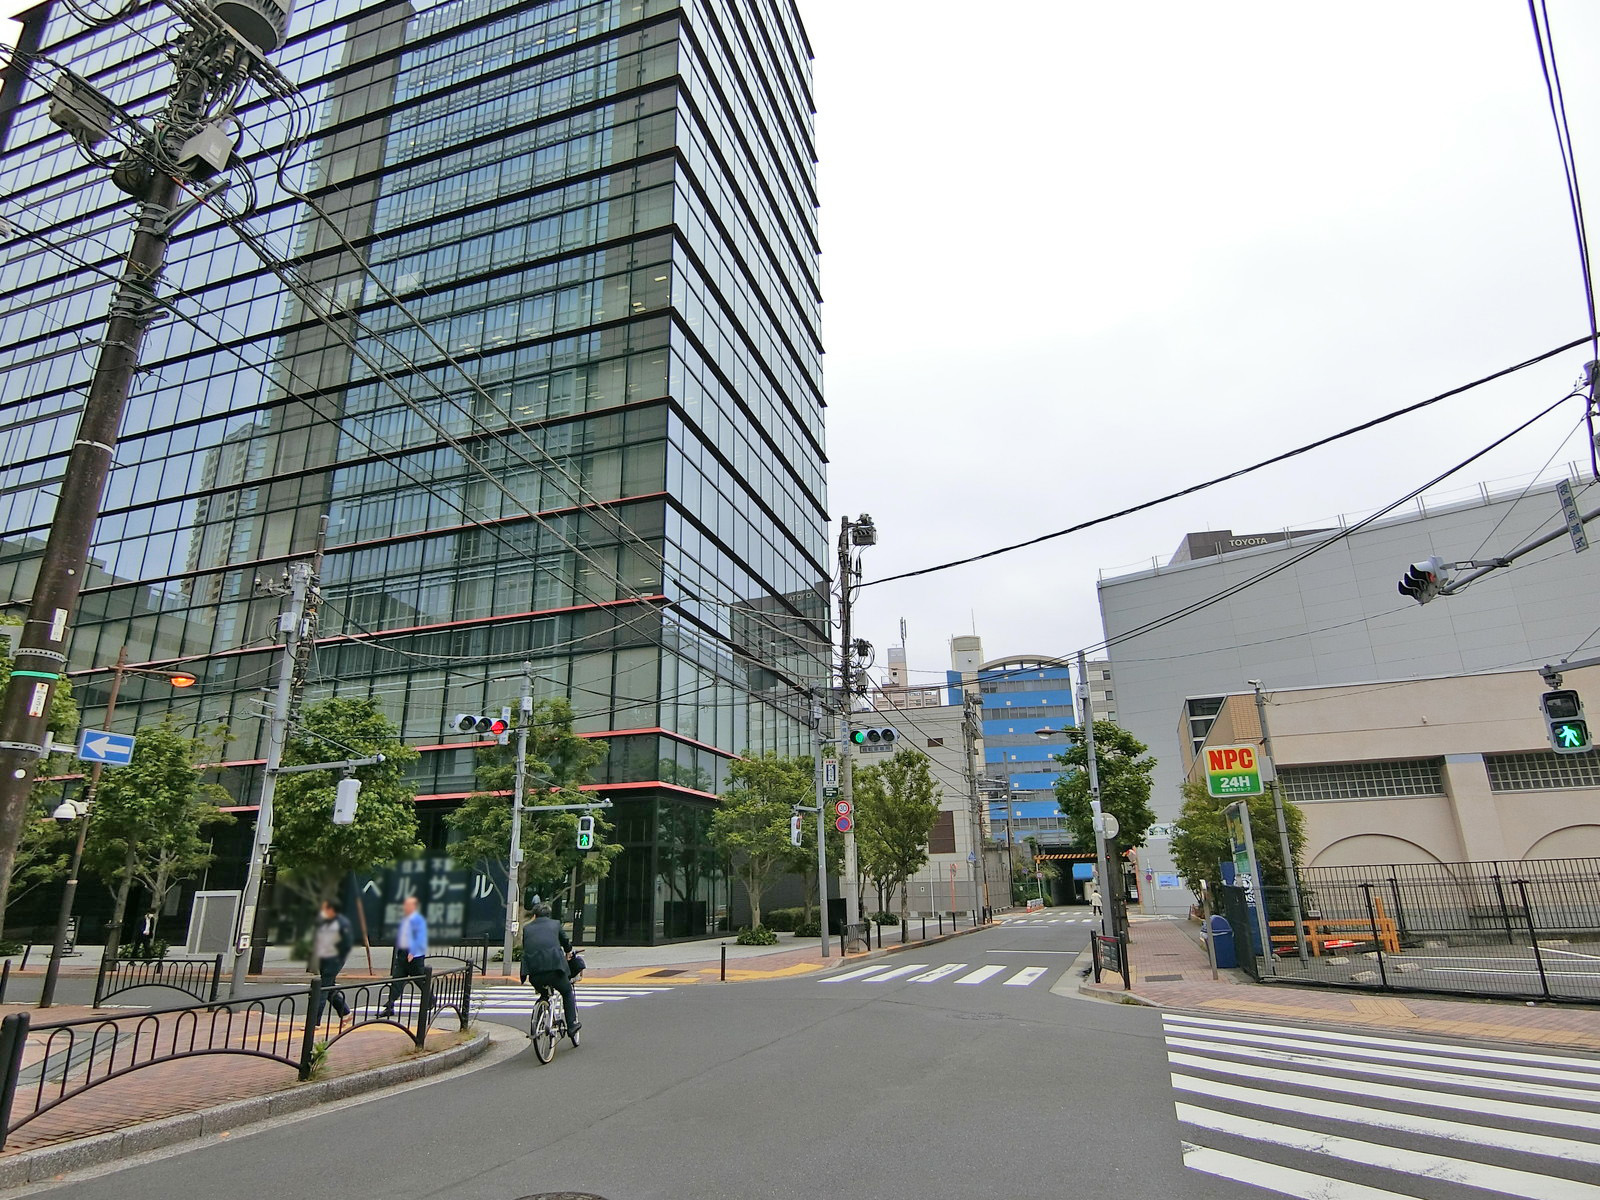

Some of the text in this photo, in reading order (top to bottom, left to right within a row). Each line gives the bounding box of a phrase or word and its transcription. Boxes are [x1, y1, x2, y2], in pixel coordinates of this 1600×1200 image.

[1229, 537, 1268, 547] TOYOTA
[1208, 748, 1254, 771] NPC
[1220, 776, 1250, 788] 24H
[839, 804, 847, 812] 30
